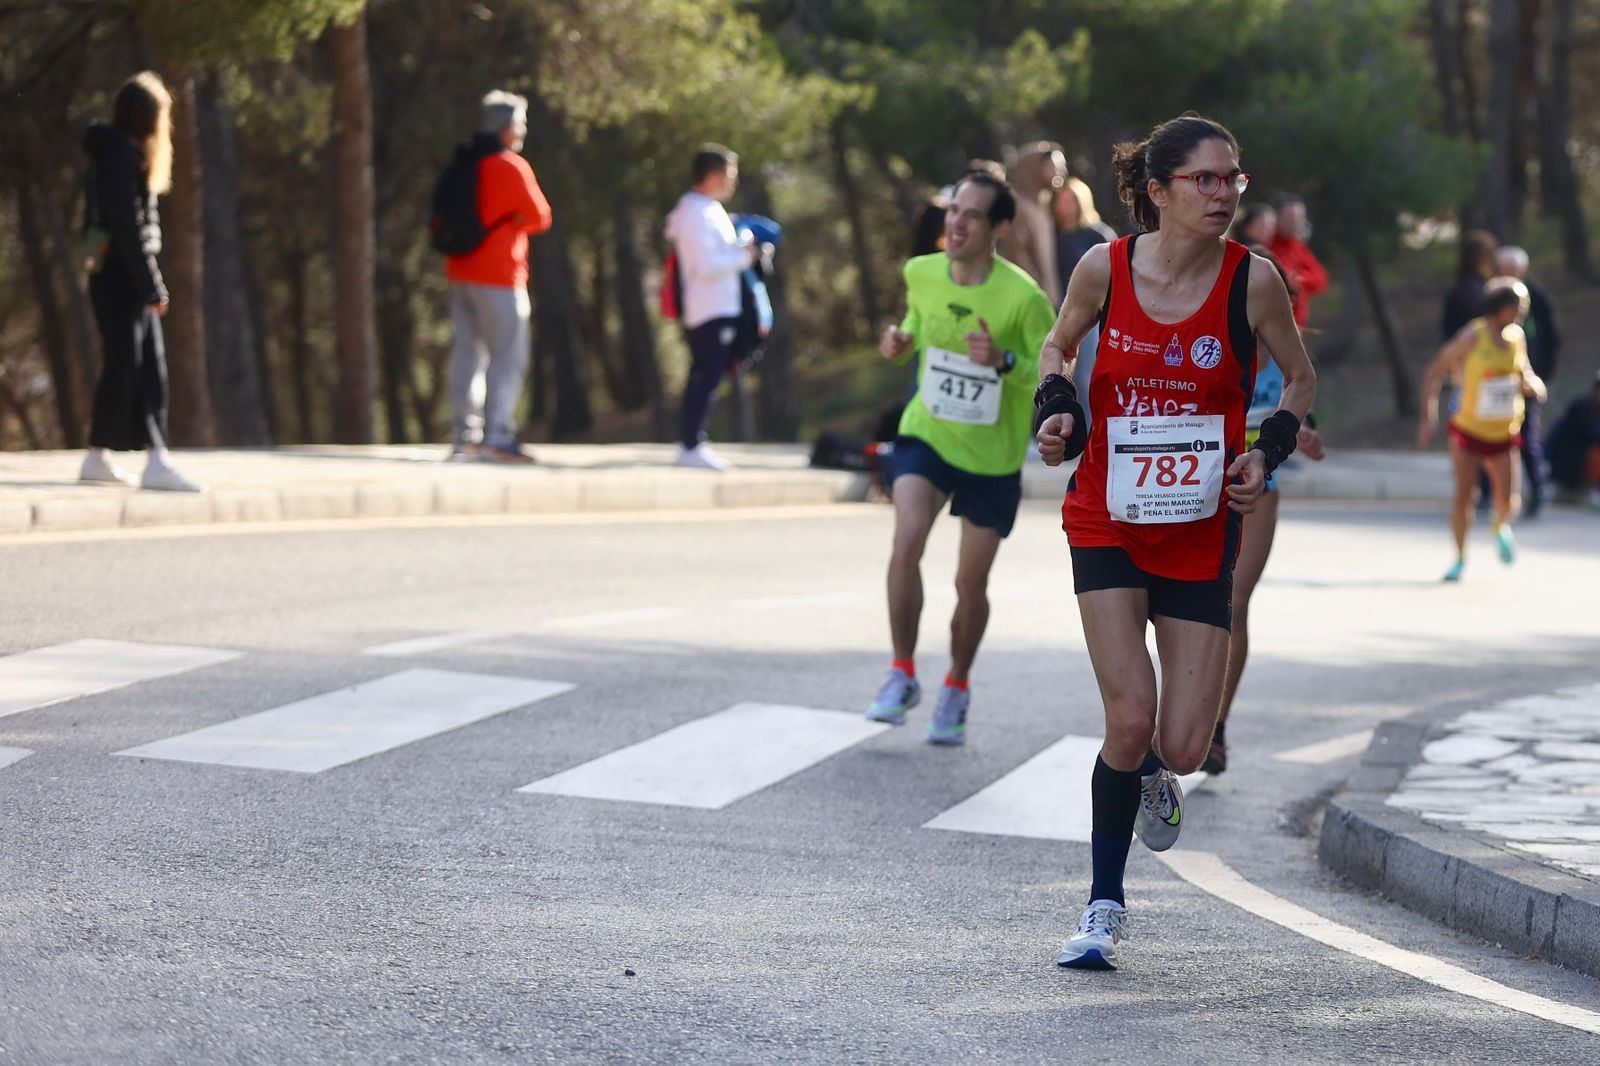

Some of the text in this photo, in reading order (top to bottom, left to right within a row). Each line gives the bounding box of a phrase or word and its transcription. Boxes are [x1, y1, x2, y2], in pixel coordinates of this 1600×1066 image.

[940, 377, 984, 402] 417
[1127, 377, 1197, 391] ATLETISMO
[1133, 454, 1201, 487] 782
[1170, 498, 1205, 506] MARATÓN
[1174, 507, 1202, 515] BASTÓN
